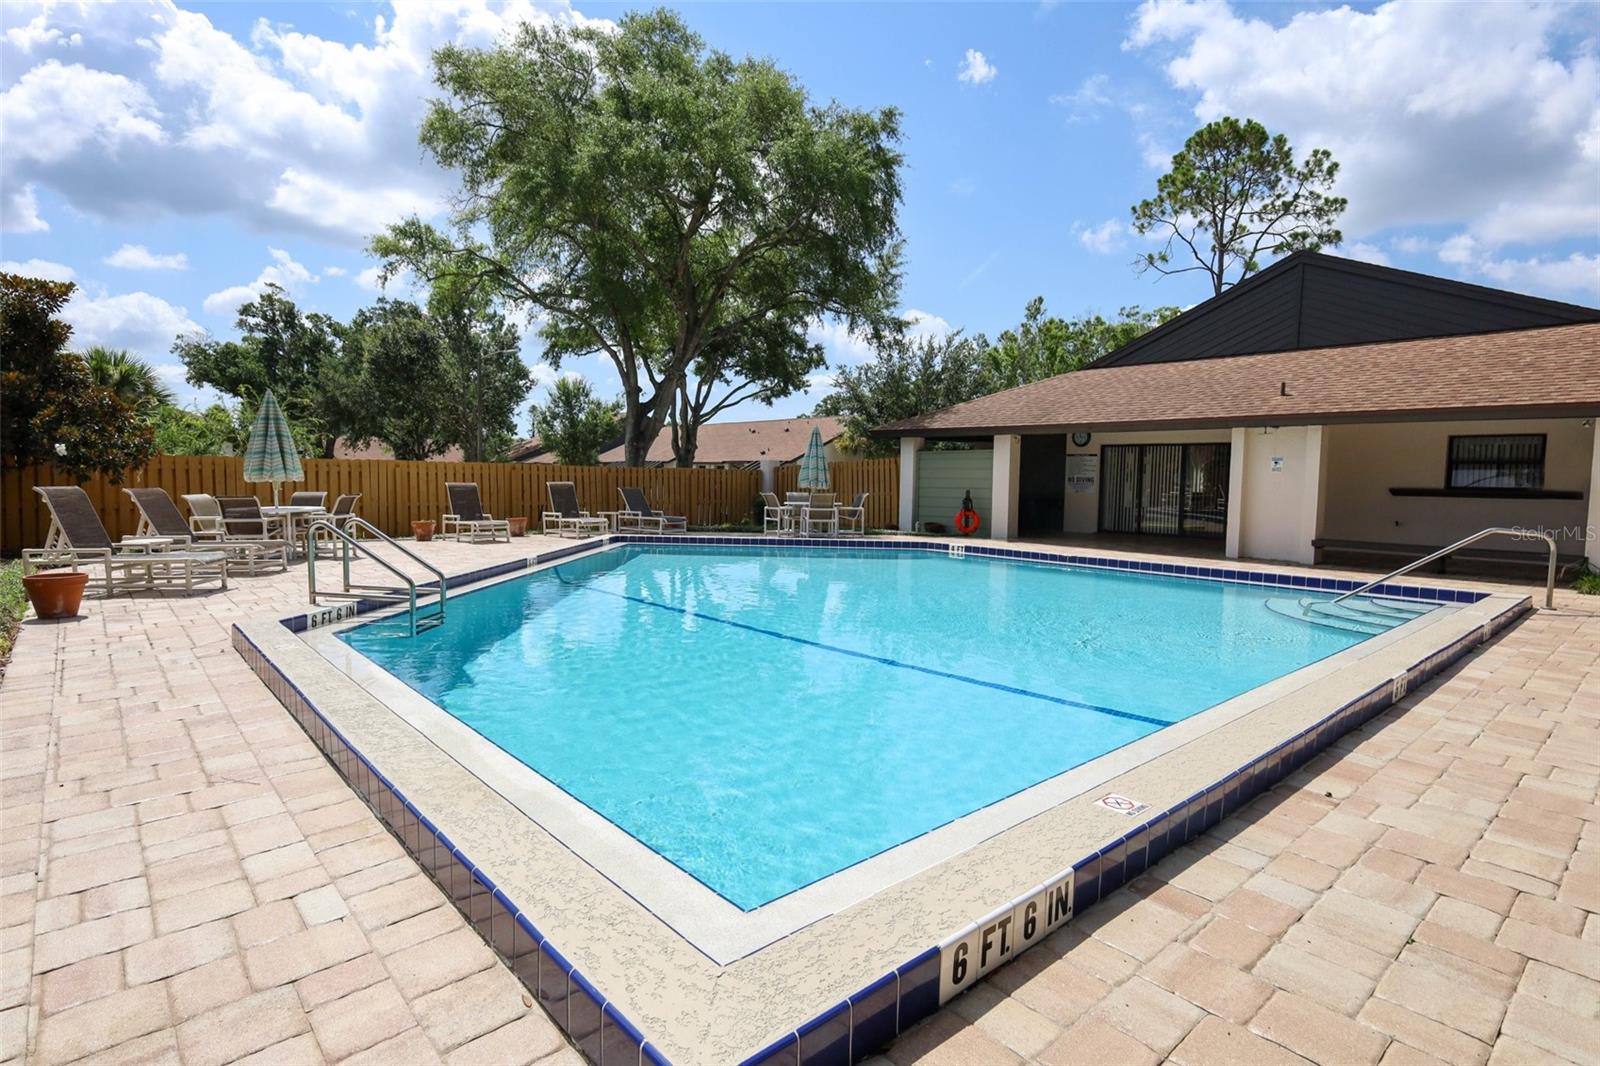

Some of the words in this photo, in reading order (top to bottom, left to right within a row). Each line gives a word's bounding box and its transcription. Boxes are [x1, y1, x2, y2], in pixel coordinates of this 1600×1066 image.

[311, 614, 318, 628] 6
[321, 610, 333, 625] FT
[336, 607, 342, 621] 6
[345, 604, 355, 619] IN
[952, 942, 968, 985] 6
[981, 915, 1012, 968] FT.
[1023, 901, 1037, 940] 6
[1047, 881, 1072, 927] IN.
